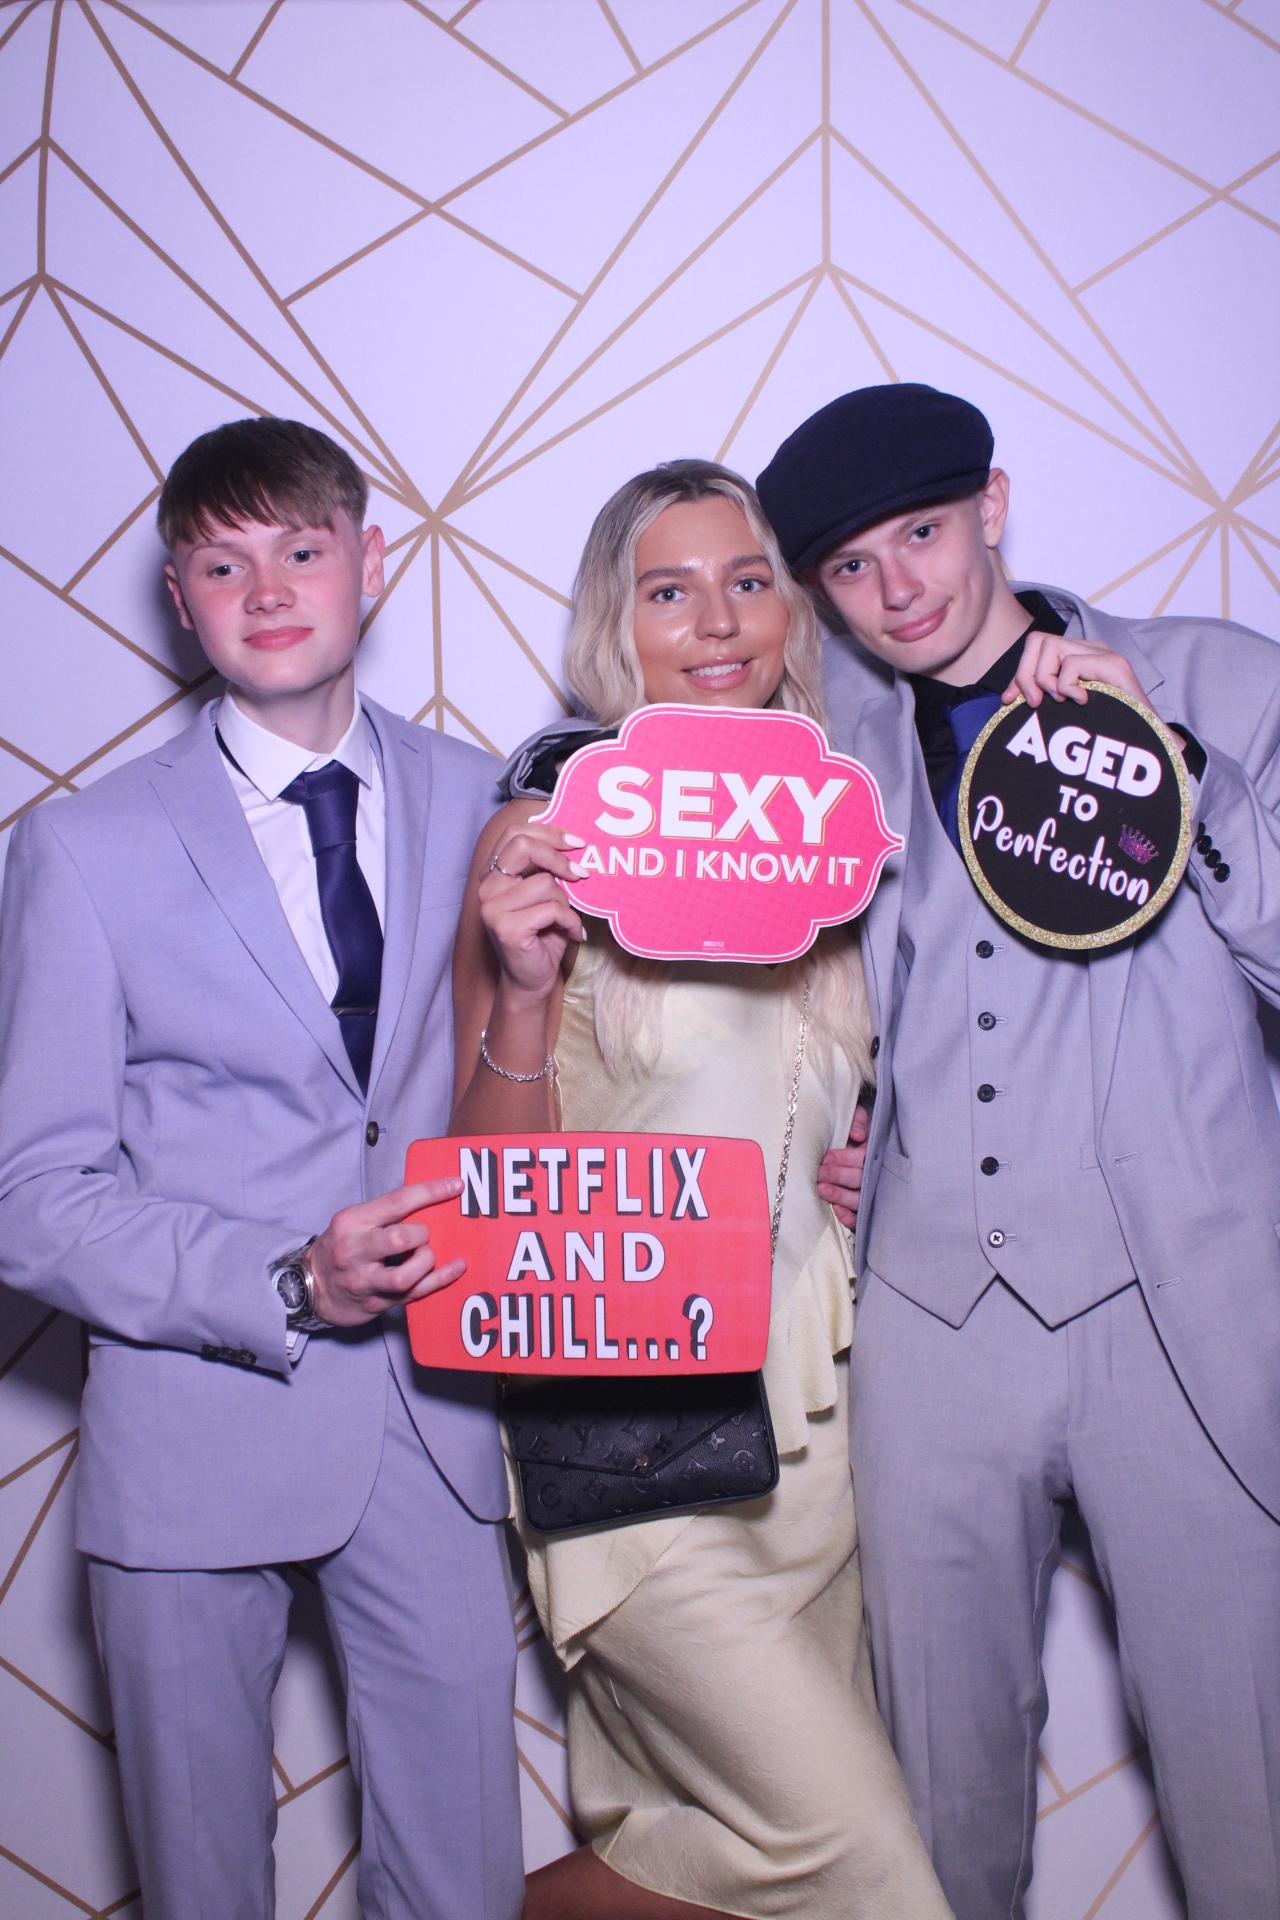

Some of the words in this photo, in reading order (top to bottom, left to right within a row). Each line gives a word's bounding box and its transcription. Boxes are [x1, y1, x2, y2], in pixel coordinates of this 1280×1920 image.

[1005, 711, 1162, 797] AGED
[595, 765, 852, 846] SEXY
[1058, 785, 1099, 822] TO
[579, 845, 665, 877] AND
[675, 849, 686, 879] I
[696, 850, 820, 885] KNOW
[827, 856, 862, 887] IT
[973, 795, 1150, 905] Perfection
[459, 1147, 709, 1220] NETFLIX
[506, 1231, 666, 1282] AND
[460, 1292, 714, 1361] CHILL...?
